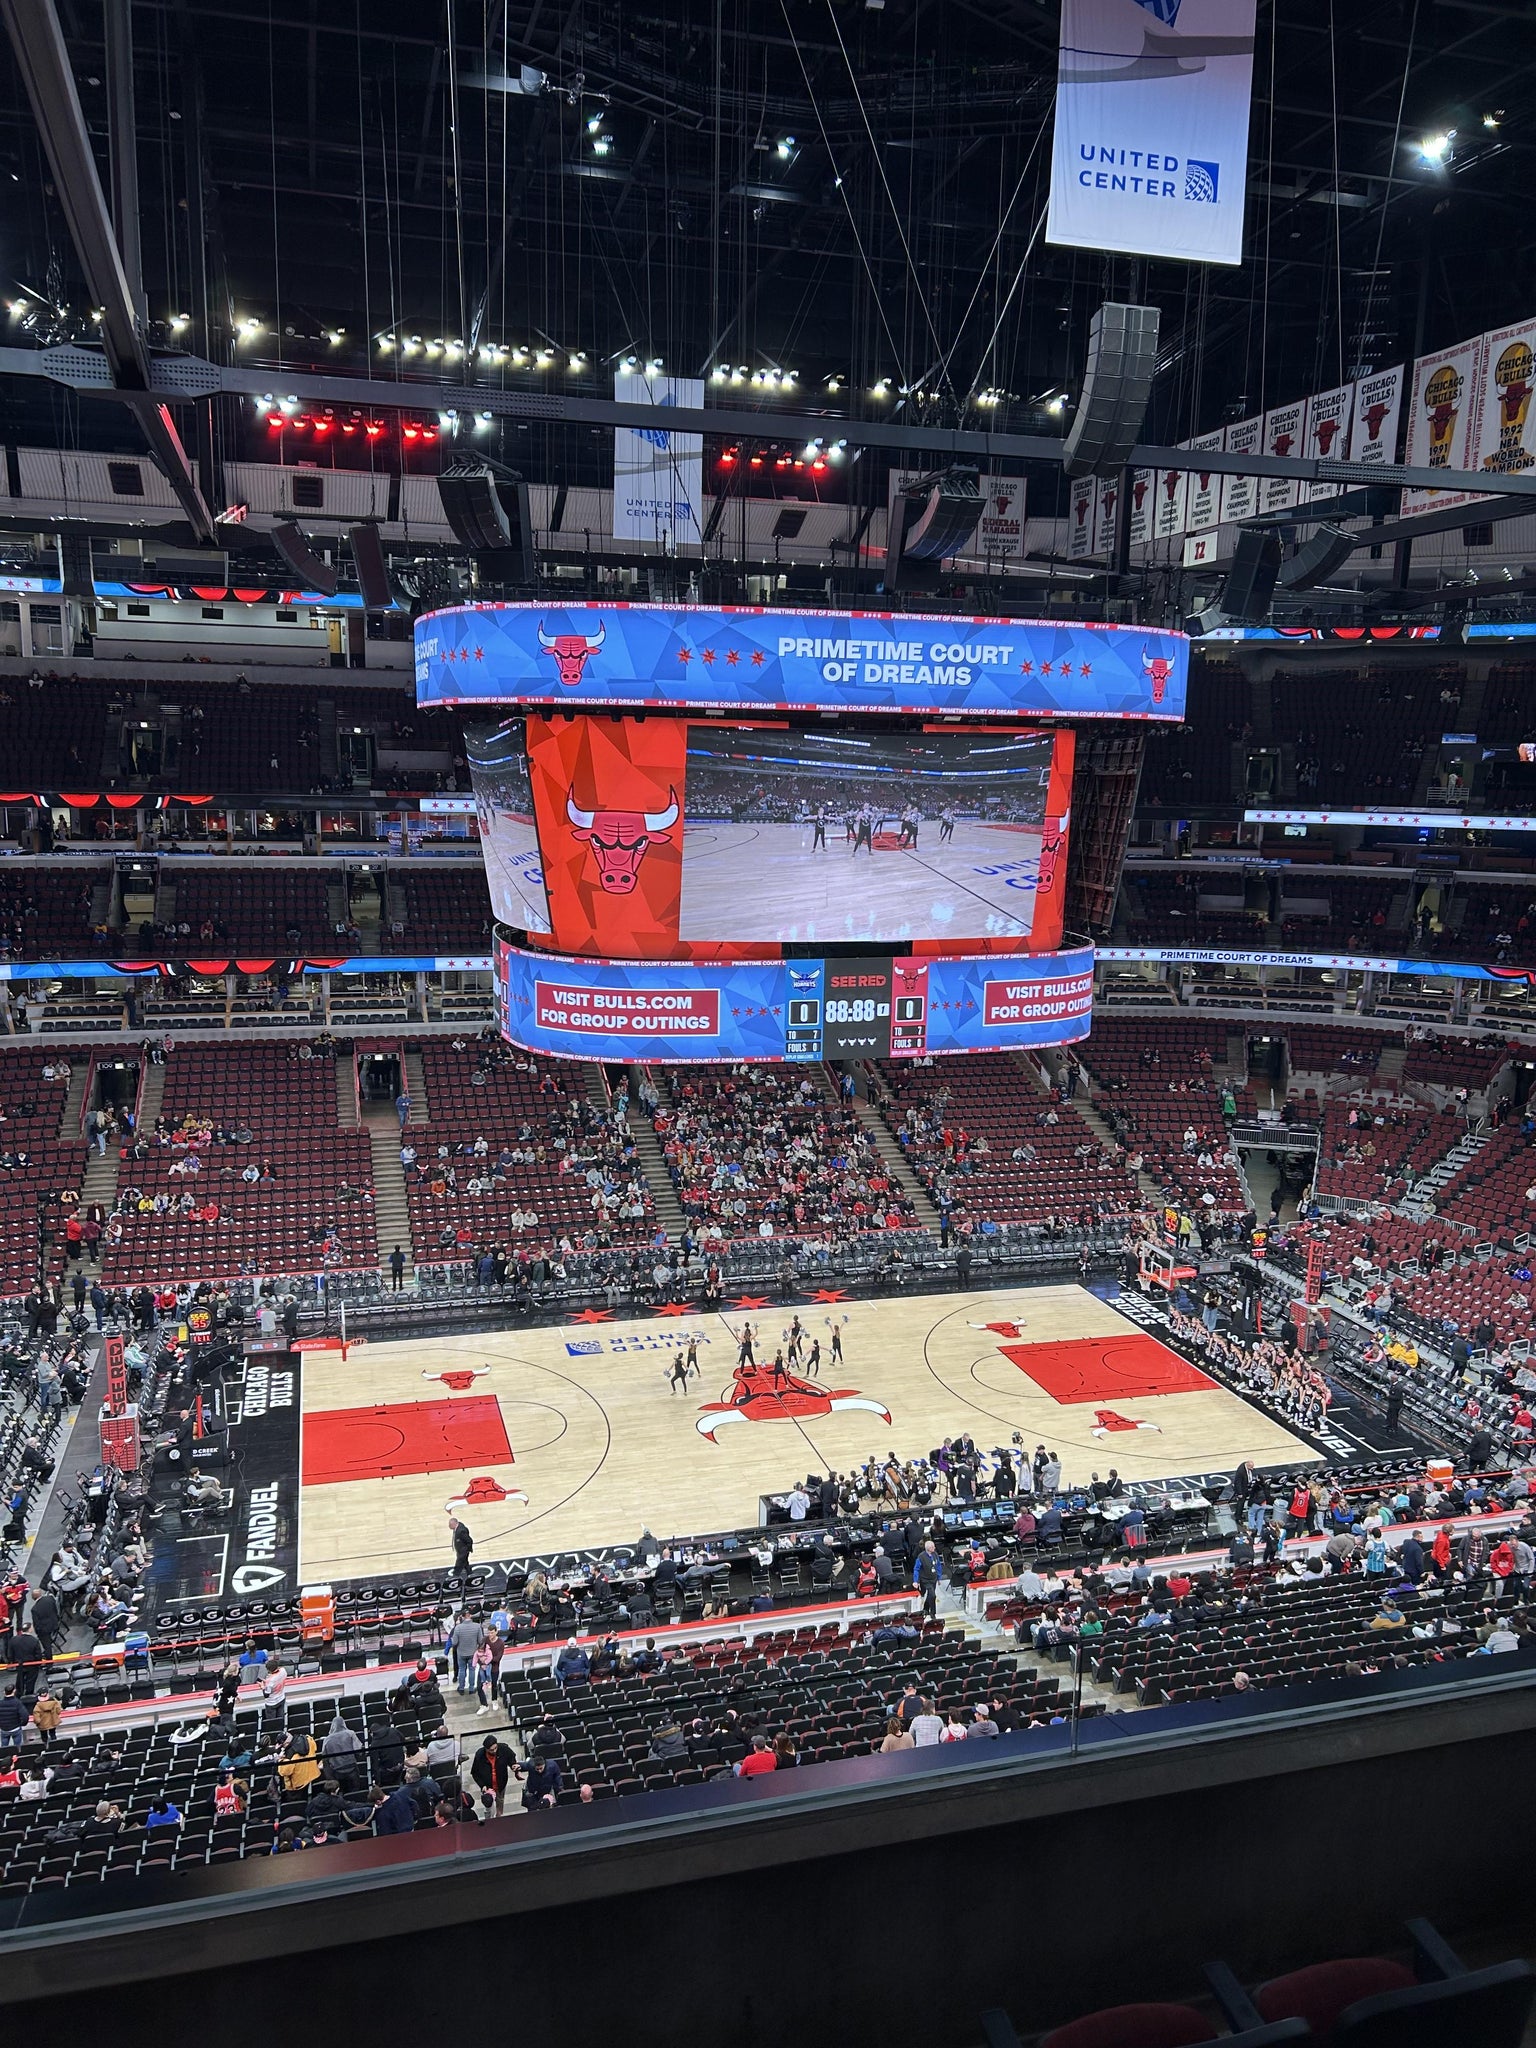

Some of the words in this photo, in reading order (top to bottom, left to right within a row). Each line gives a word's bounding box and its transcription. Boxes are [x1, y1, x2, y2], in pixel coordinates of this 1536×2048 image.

[1080, 144, 1178, 172] UNITED
[1079, 170, 1176, 198] CENTER
[1361, 374, 1397, 395] CHICAGO
[1428, 375, 1464, 394] CHICAGO
[1503, 367, 1532, 384] BULLS
[1312, 392, 1346, 411] CHICAGO
[1365, 388, 1391, 406] BULLS
[1432, 389, 1458, 406] BULLS
[1270, 408, 1300, 426] CHICAGO
[1316, 405, 1341, 420] BULLS
[1230, 423, 1258, 440] CHICAGO
[1273, 421, 1295, 436] BULLS
[1499, 423, 1523, 438] 1992
[1233, 435, 1254, 452] BULLS
[1429, 443, 1448, 457] 1991
[1499, 437, 1519, 450] NBA
[1491, 447, 1525, 464] WORLD
[627, 498, 671, 508] UNITED
[627, 509, 671, 519] CENTER
[983, 519, 1020, 527] GENERAL
[982, 527, 1020, 535] MANAGER
[629, 602, 663, 610] PRIMETIME
[778, 637, 923, 663] PRIMETIME
[930, 643, 1014, 665] COURT
[822, 662, 856, 682] OF
[864, 666, 972, 686] DREAMS
[1160, 951, 1214, 960] PRIMETIME
[1216, 952, 1251, 962] COURT
[1253, 954, 1269, 963] OF
[1270, 955, 1313, 964] DREAMS
[831, 976, 857, 988] SEE
[858, 975, 886, 987] RED
[1006, 985, 1042, 999] VISIT
[1044, 977, 1091, 997] BULLS.COM
[552, 990, 590, 1007] VISIT
[593, 994, 692, 1009] BULLS.COM
[541, 1008, 567, 1024] FOR
[570, 1013, 628, 1029] GROUP
[632, 1016, 710, 1029] OUTINGS
[800, 1003, 808, 1022] 0
[826, 999, 875, 1023] 88:88
[906, 1000, 914, 1019] 0
[991, 1005, 1020, 1019] FOR
[1022, 1001, 1066, 1017] GROUP
[788, 1031, 796, 1039] TO
[813, 1030, 817, 1039] 7
[894, 1027, 903, 1036] TO
[917, 1026, 922, 1035] 7
[787, 1043, 807, 1052] FOULS
[812, 1042, 817, 1052] 0
[893, 1039, 912, 1048] FOULS
[916, 1038, 922, 1047] 0
[1311, 1245, 1323, 1272] SEE
[1107, 1298, 1157, 1325] BULLS
[193, 1320, 207, 1328] 55
[110, 1343, 123, 1379] RED
[112, 1380, 126, 1415] SEE
[243, 1366, 270, 1417] CHICAGO
[270, 1372, 294, 1408] BULLS
[246, 1481, 279, 1561] FANDUEL
